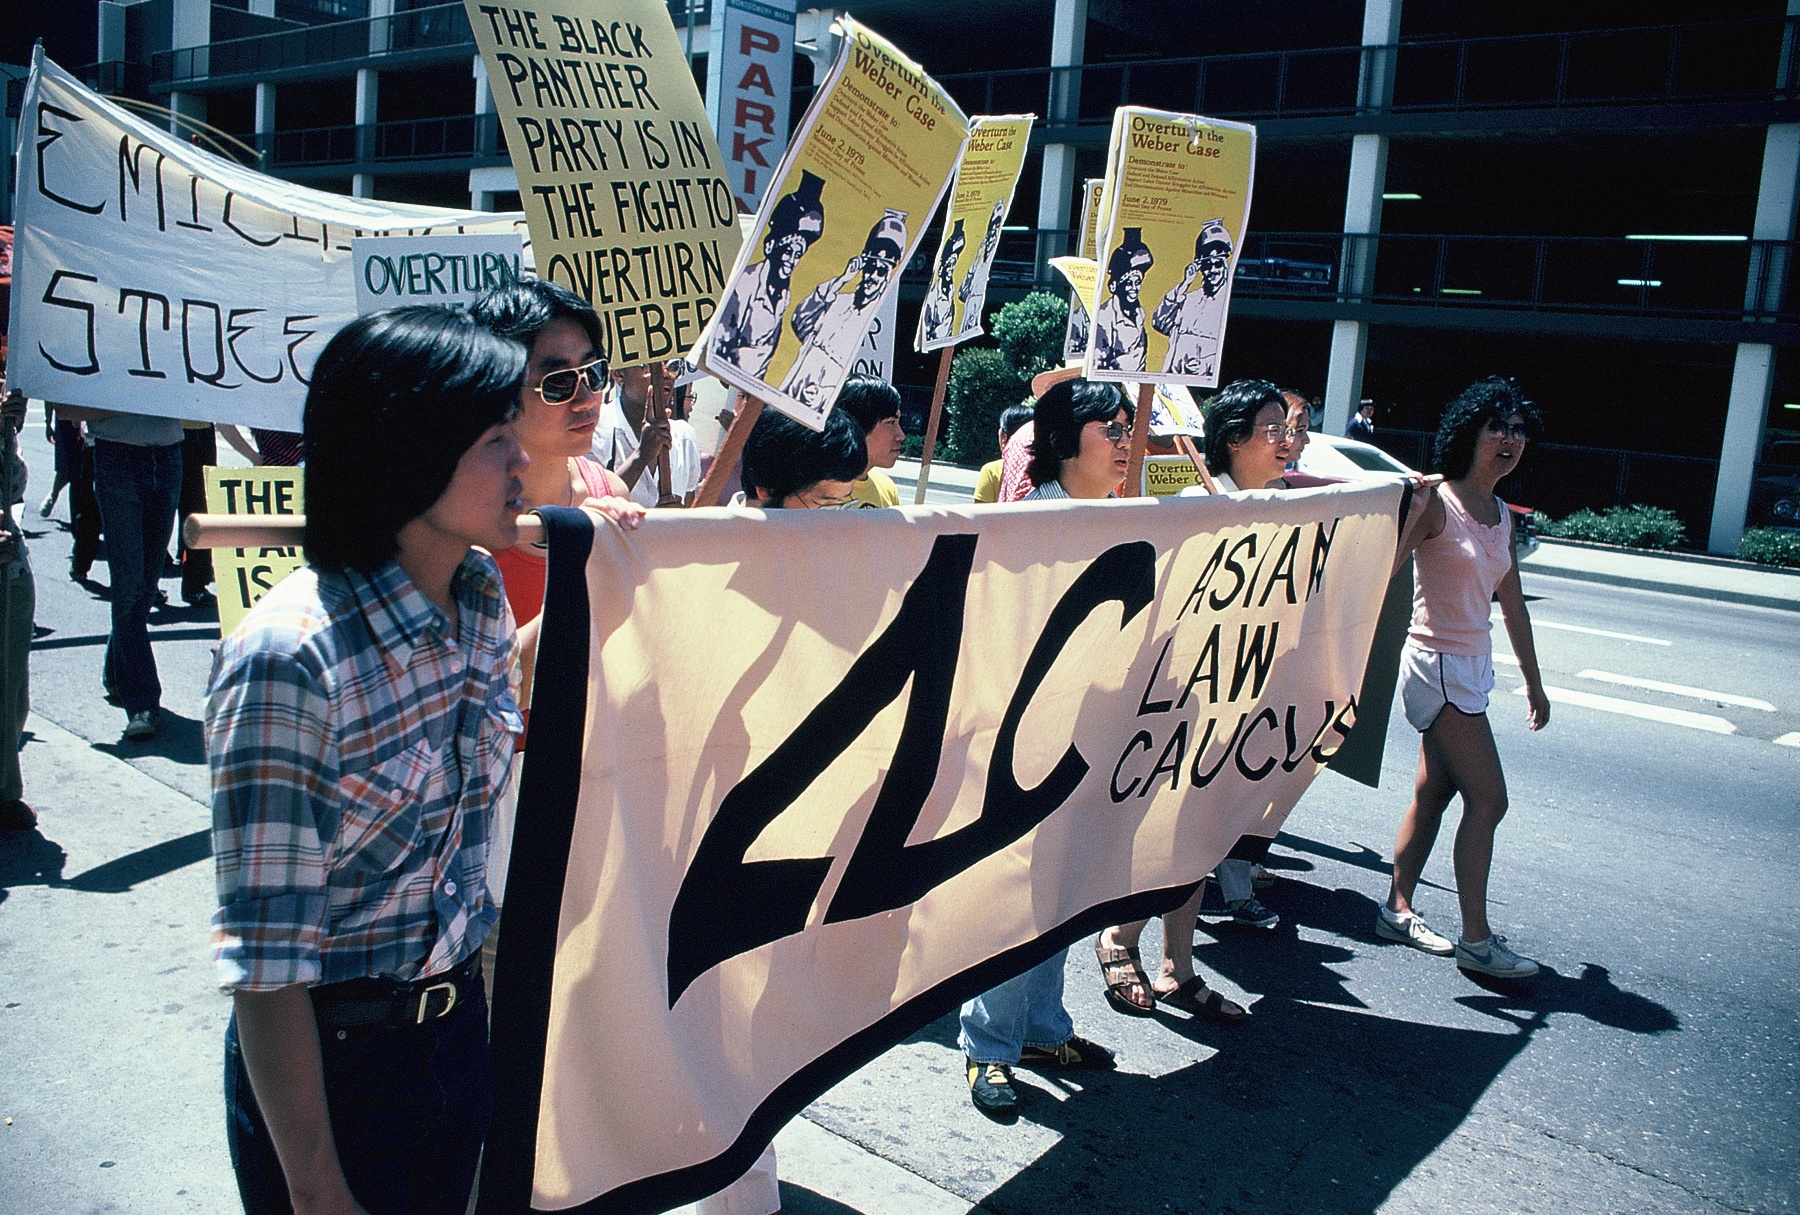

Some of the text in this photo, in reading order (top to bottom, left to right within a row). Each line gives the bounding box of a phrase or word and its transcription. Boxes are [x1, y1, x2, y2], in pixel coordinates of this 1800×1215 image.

[480, 5, 653, 59] THE BLACK
[496, 52, 660, 111] PANTHER
[854, 48, 936, 131] Weber Case
[857, 31, 946, 116] Overturn the
[842, 77, 890, 119] Demonstrate
[517, 116, 712, 174] PARTY IS IN
[816, 125, 838, 144] June
[845, 147, 865, 165] 1979
[968, 139, 1012, 151] Weber Case
[971, 127, 1007, 138] Overturn
[1132, 133, 1220, 158] Weber Case
[1207, 130, 1224, 143] the
[1129, 156, 1175, 168] Demonstrate
[532, 177, 734, 241] THE FIGHT TO
[1123, 195, 1141, 204] June
[1150, 197, 1168, 206] 1979
[364, 251, 520, 296] OVERTURN
[547, 239, 727, 307] OVERTURN
[220, 480, 294, 515] THE
[1149, 474, 1189, 484] Weber
[1176, 517, 1340, 620] ASIAN
[1137, 621, 1279, 717] LAW
[1109, 694, 1358, 803] CAUCUS
